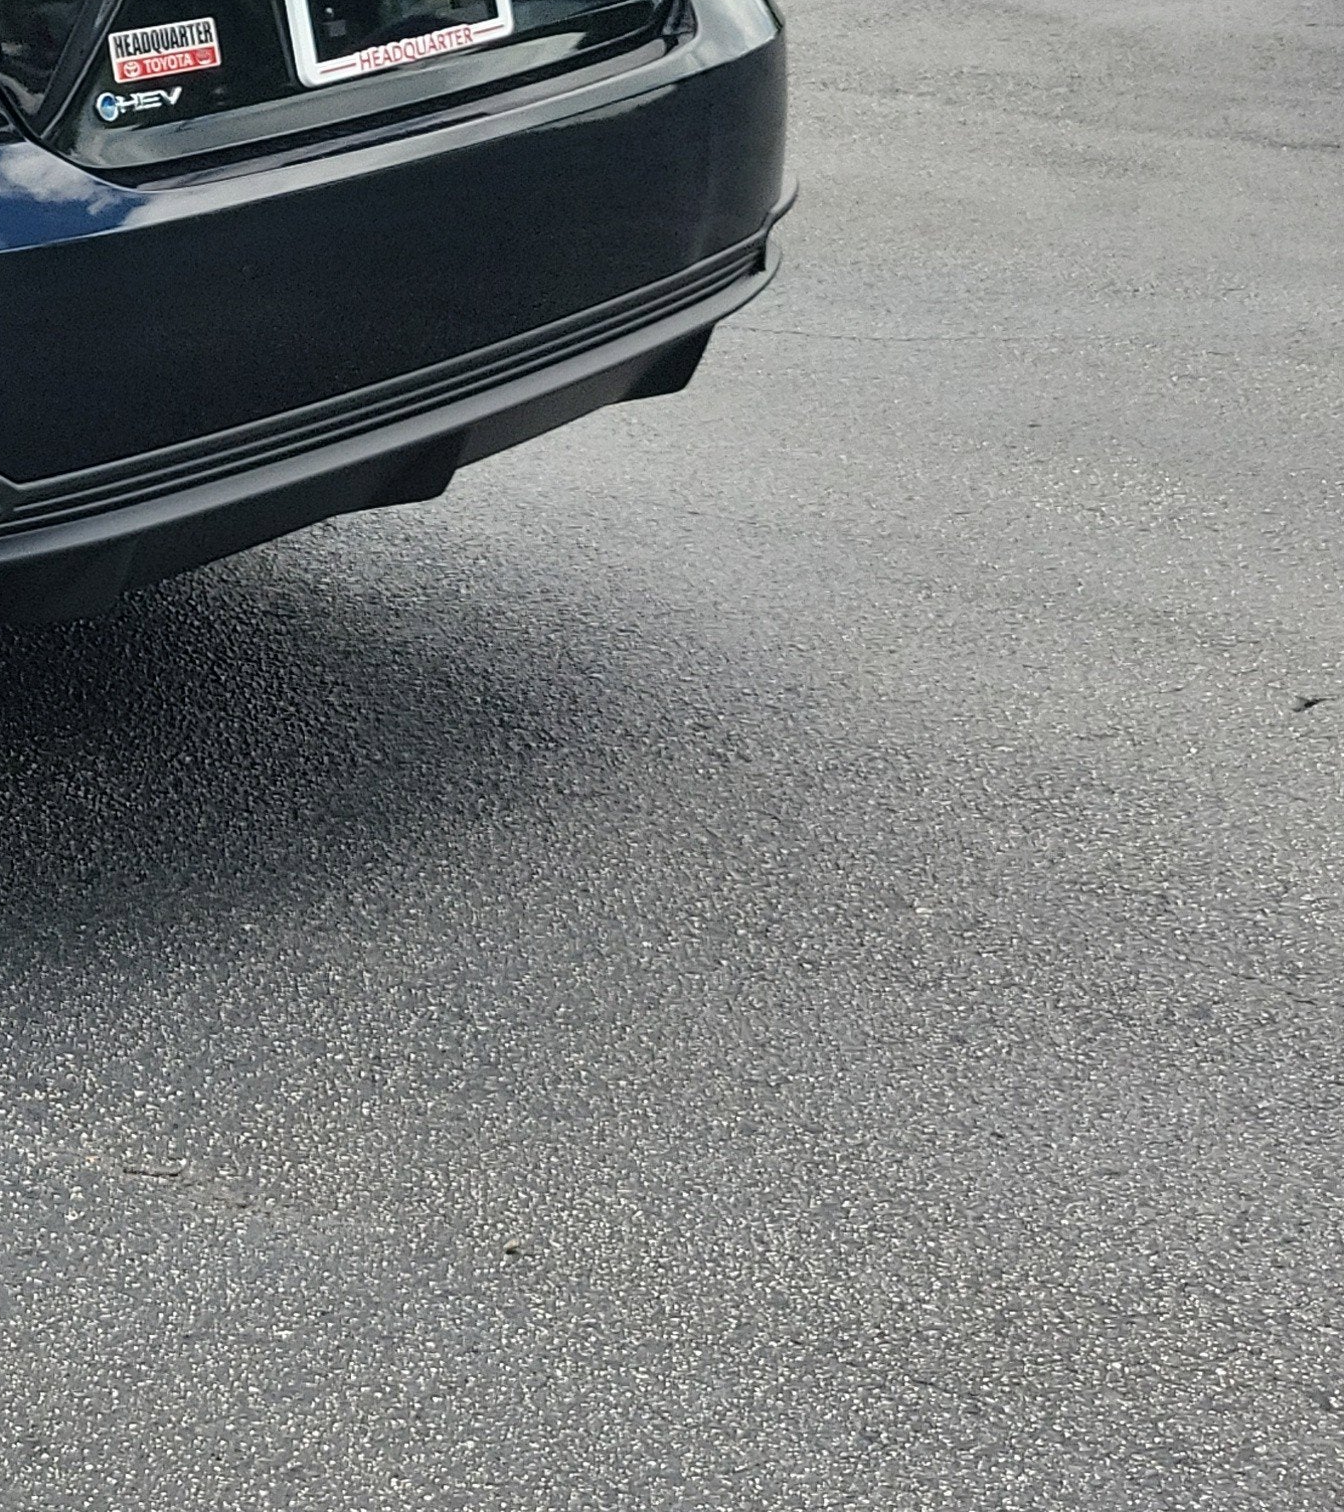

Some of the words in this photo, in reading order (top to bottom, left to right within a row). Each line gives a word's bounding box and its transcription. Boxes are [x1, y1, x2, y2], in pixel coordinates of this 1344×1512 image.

[113, 20, 213, 59] HEADQUARTER
[359, 27, 473, 70] HEADQUARTER
[143, 53, 194, 73] TOYOTA
[116, 86, 183, 114] HEV
